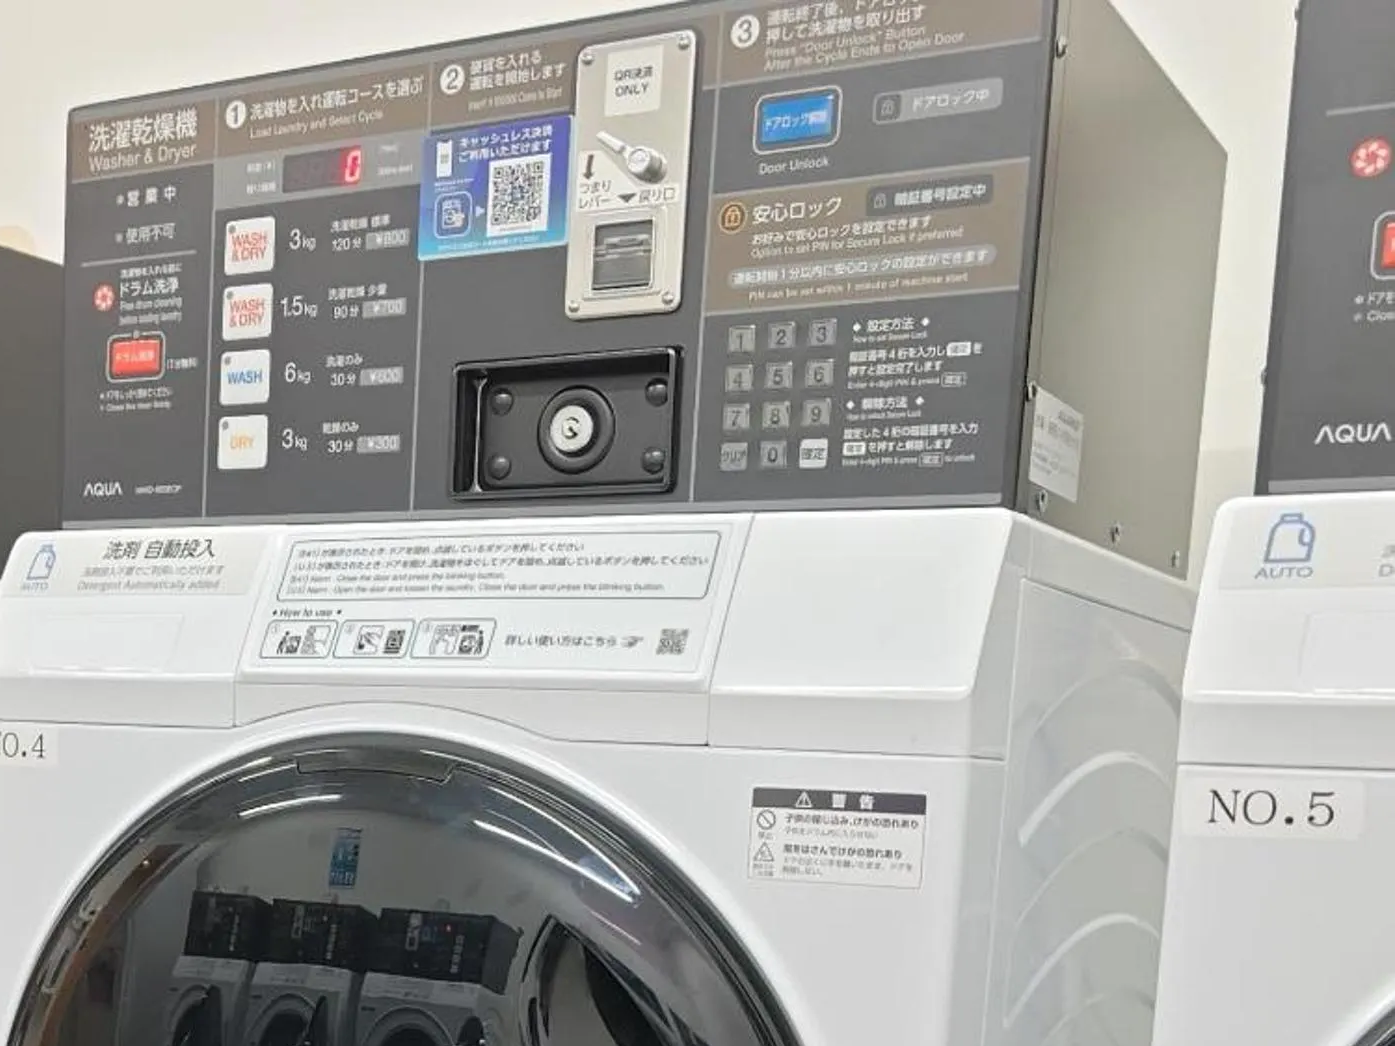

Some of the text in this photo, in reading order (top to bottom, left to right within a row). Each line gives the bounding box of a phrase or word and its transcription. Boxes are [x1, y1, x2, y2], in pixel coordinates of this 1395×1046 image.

[934, 32, 965, 46] Door
[615, 82, 650, 97] ONLY
[912, 88, 990, 110] ドアロック中
[88, 107, 198, 153] 洗濯乾燥機
[88, 143, 198, 174] Washer & Dryer
[344, 148, 362, 184] 0
[758, 160, 788, 174] Door
[579, 180, 612, 195] つまり
[579, 194, 612, 208] レバー
[752, 196, 842, 225] 安心ロック
[230, 231, 268, 248] WASH
[228, 298, 265, 314] WASH
[776, 328, 787, 346] 2
[816, 325, 827, 343] 3
[227, 368, 263, 385] WASH
[732, 371, 744, 388] 4
[772, 368, 784, 386] 5
[813, 365, 825, 383] 6
[731, 409, 742, 427] 7
[769, 407, 781, 425] 8
[810, 405, 822, 423] 9
[1314, 421, 1392, 445] AQUA
[230, 435, 254, 450] DRY
[327, 439, 354, 453] 30分
[767, 446, 779, 464] 0
[83, 482, 123, 498] AQUA
[103, 538, 216, 561] 洗剤 自動投入
[1254, 567, 1314, 580] AUTO
[1208, 788, 1336, 828] NO.5
